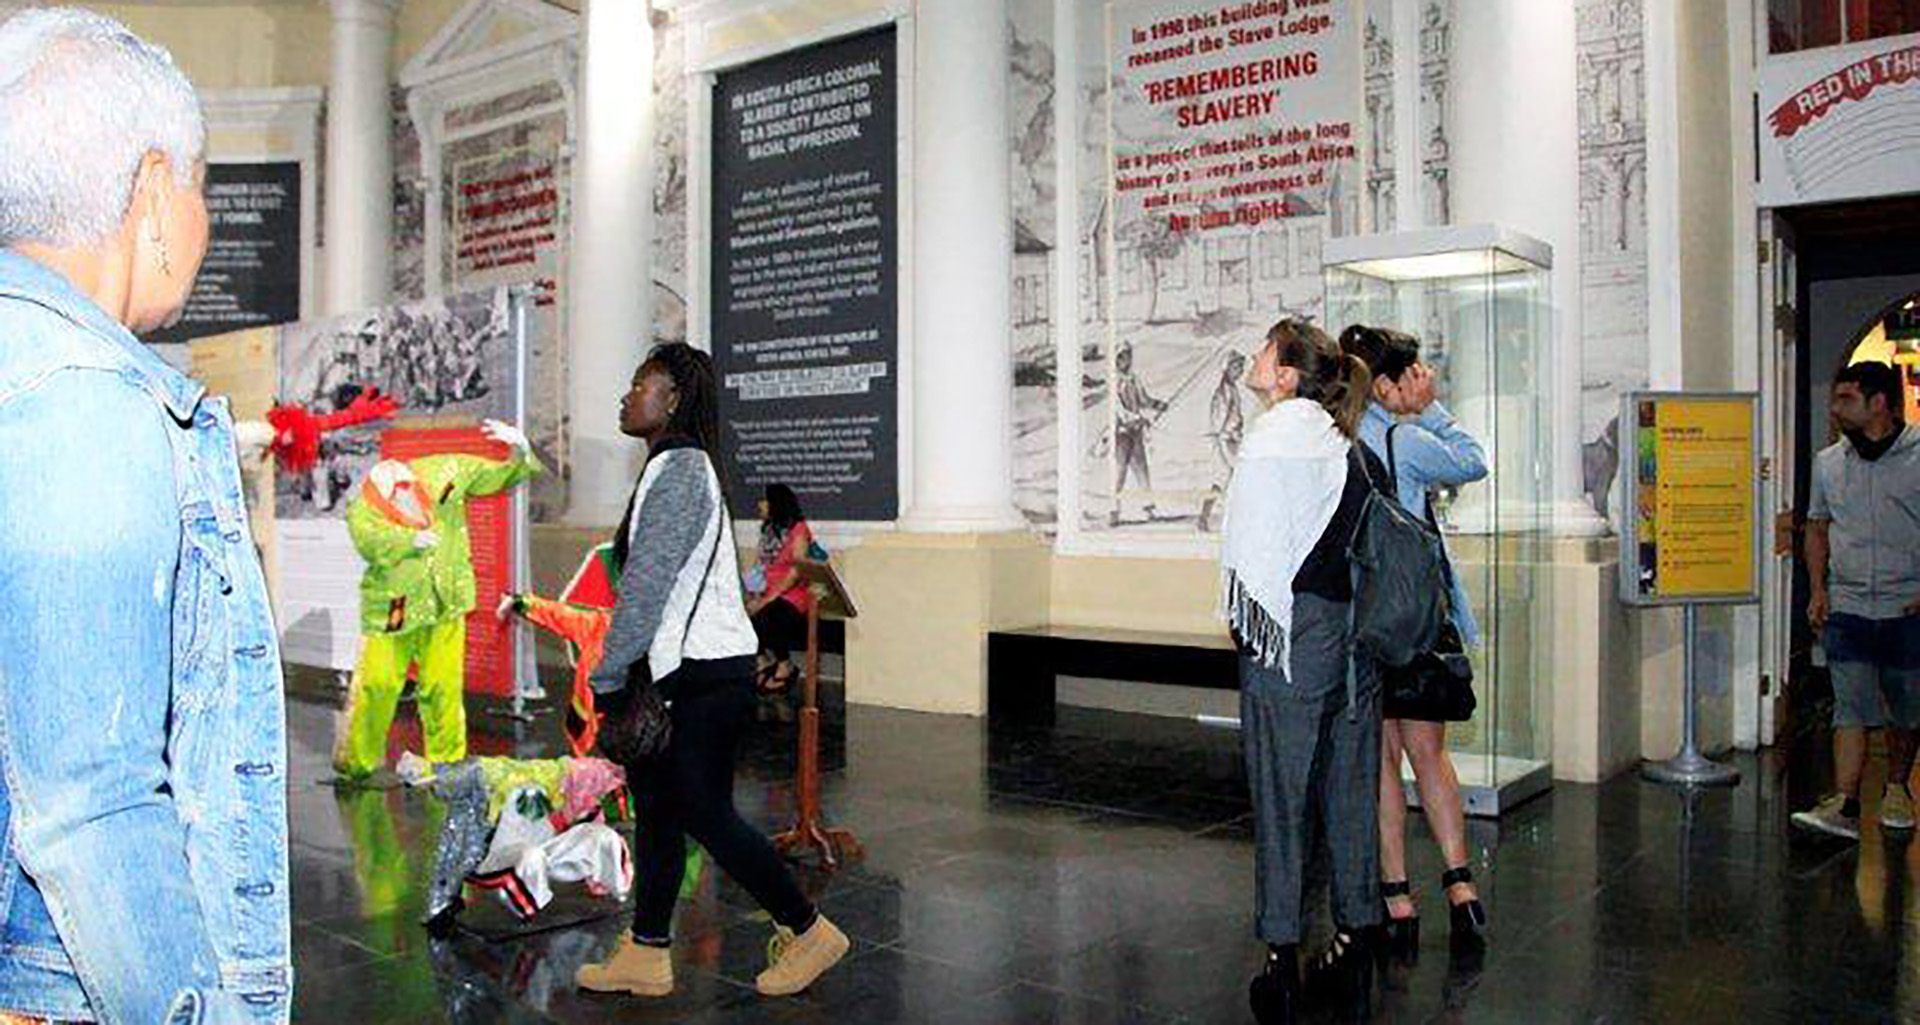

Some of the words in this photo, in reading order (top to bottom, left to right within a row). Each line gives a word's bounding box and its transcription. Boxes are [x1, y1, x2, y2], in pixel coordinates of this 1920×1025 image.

[1128, 39, 1194, 67] renamed
[1198, 35, 1223, 53] the
[1228, 26, 1274, 47] Slave
[1278, 13, 1335, 36] Lodge.
[1132, 28, 1146, 44] In
[1150, 20, 1184, 39] 1998
[1187, 14, 1217, 33] this
[1221, 0, 1289, 25] building
[784, 75, 823, 97] AFRICA
[825, 61, 881, 86] COLONIAL
[1144, 52, 1317, 103] 'REMEMBERING
[1796, 75, 1843, 115] RED
[1847, 62, 1872, 88] IN
[1877, 50, 1920, 78] THE
[742, 101, 788, 125] SLAVERY
[790, 83, 869, 113] CONTRIBUTED
[766, 115, 809, 138] SOCIETY
[813, 106, 851, 127] BASED
[854, 102, 872, 118] ON
[1177, 89, 1281, 128] SLAVERY'
[1133, 155, 1142, 167] a
[1198, 140, 1228, 158] that
[1230, 133, 1265, 152] tells
[1268, 128, 1286, 146] of
[1287, 124, 1312, 142] the
[1316, 121, 1350, 142] long
[1115, 168, 1163, 192] history
[1183, 161, 1237, 182] svery
[1239, 156, 1254, 174] in
[1258, 149, 1301, 171] South
[1306, 143, 1355, 163] Africa
[1143, 191, 1169, 208] and
[1219, 175, 1303, 199] awareness
[1308, 170, 1325, 184] of
[1235, 200, 1295, 227] rights.
